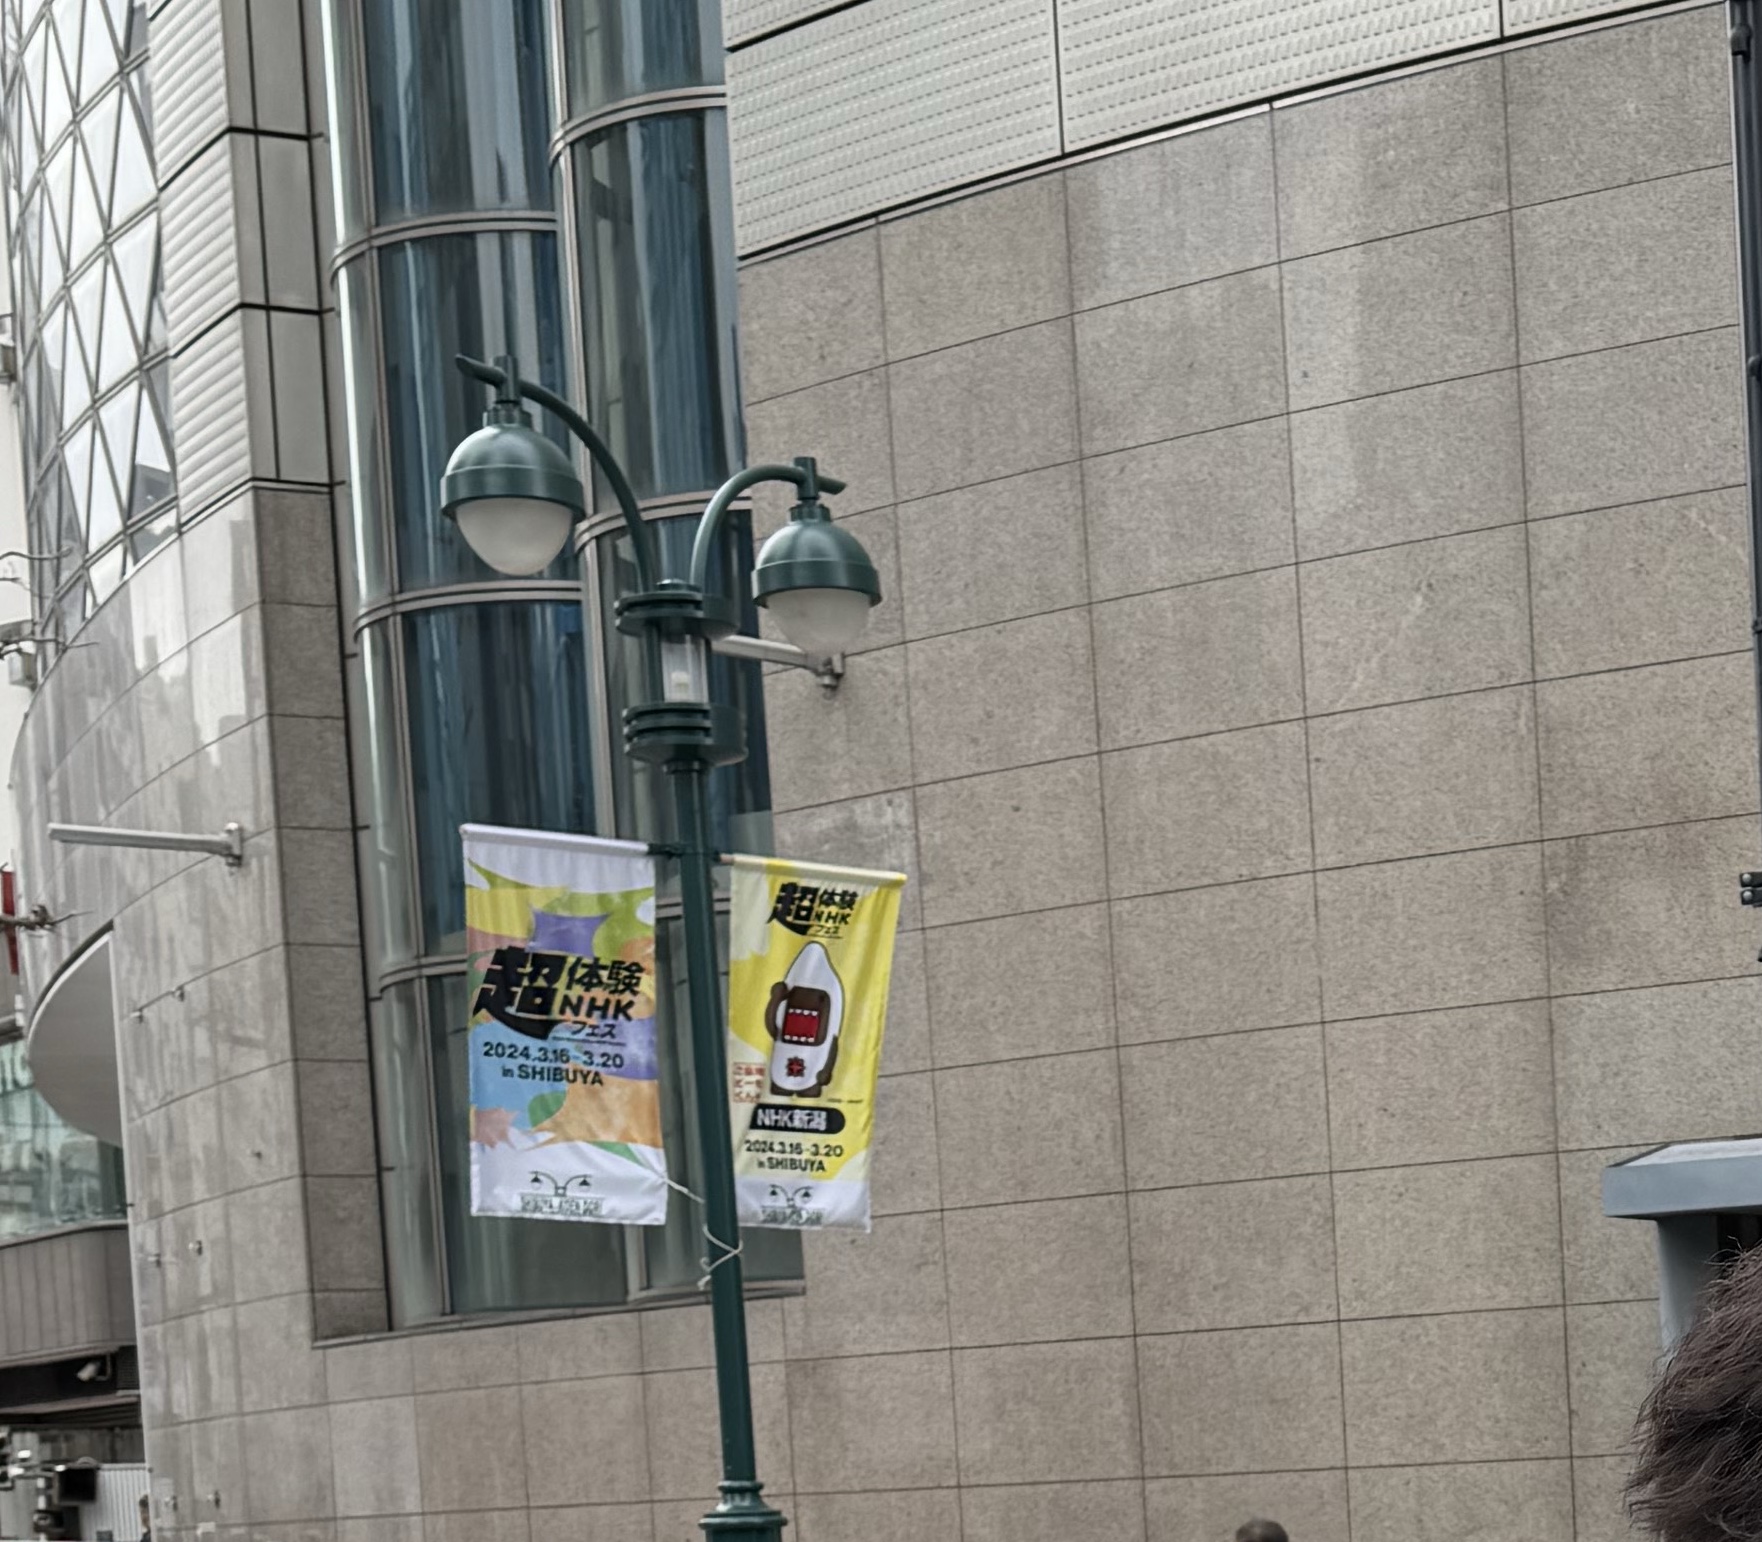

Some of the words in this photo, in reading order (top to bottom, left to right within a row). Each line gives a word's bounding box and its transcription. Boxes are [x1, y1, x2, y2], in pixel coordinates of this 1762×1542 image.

[558, 993, 636, 1023] NHK
[517, 1064, 604, 1087] SHIBUYA
[766, 1157, 826, 1173] SHIBUYA
